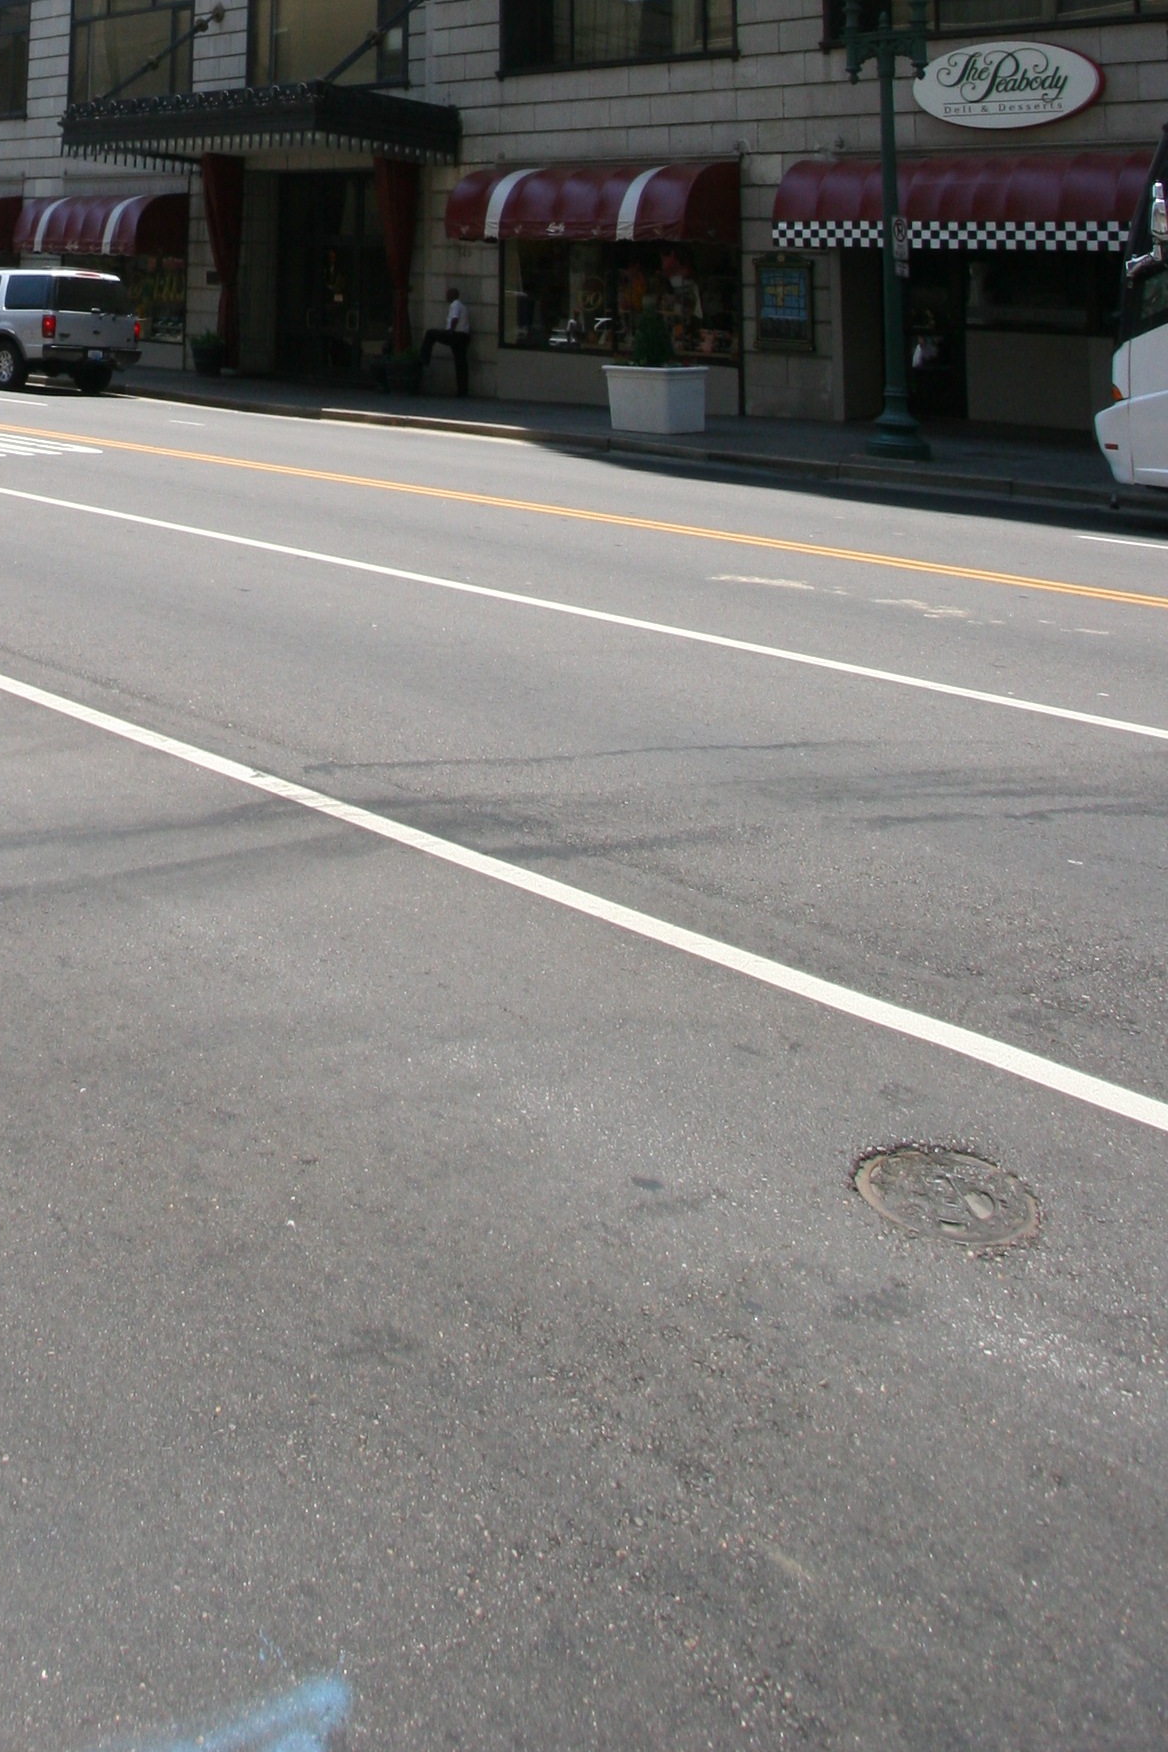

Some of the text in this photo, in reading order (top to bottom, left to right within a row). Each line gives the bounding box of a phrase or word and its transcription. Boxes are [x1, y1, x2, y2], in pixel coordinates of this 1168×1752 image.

[936, 48, 1068, 103] The Peabody
[944, 102, 1063, 114] Deli & Desserts
